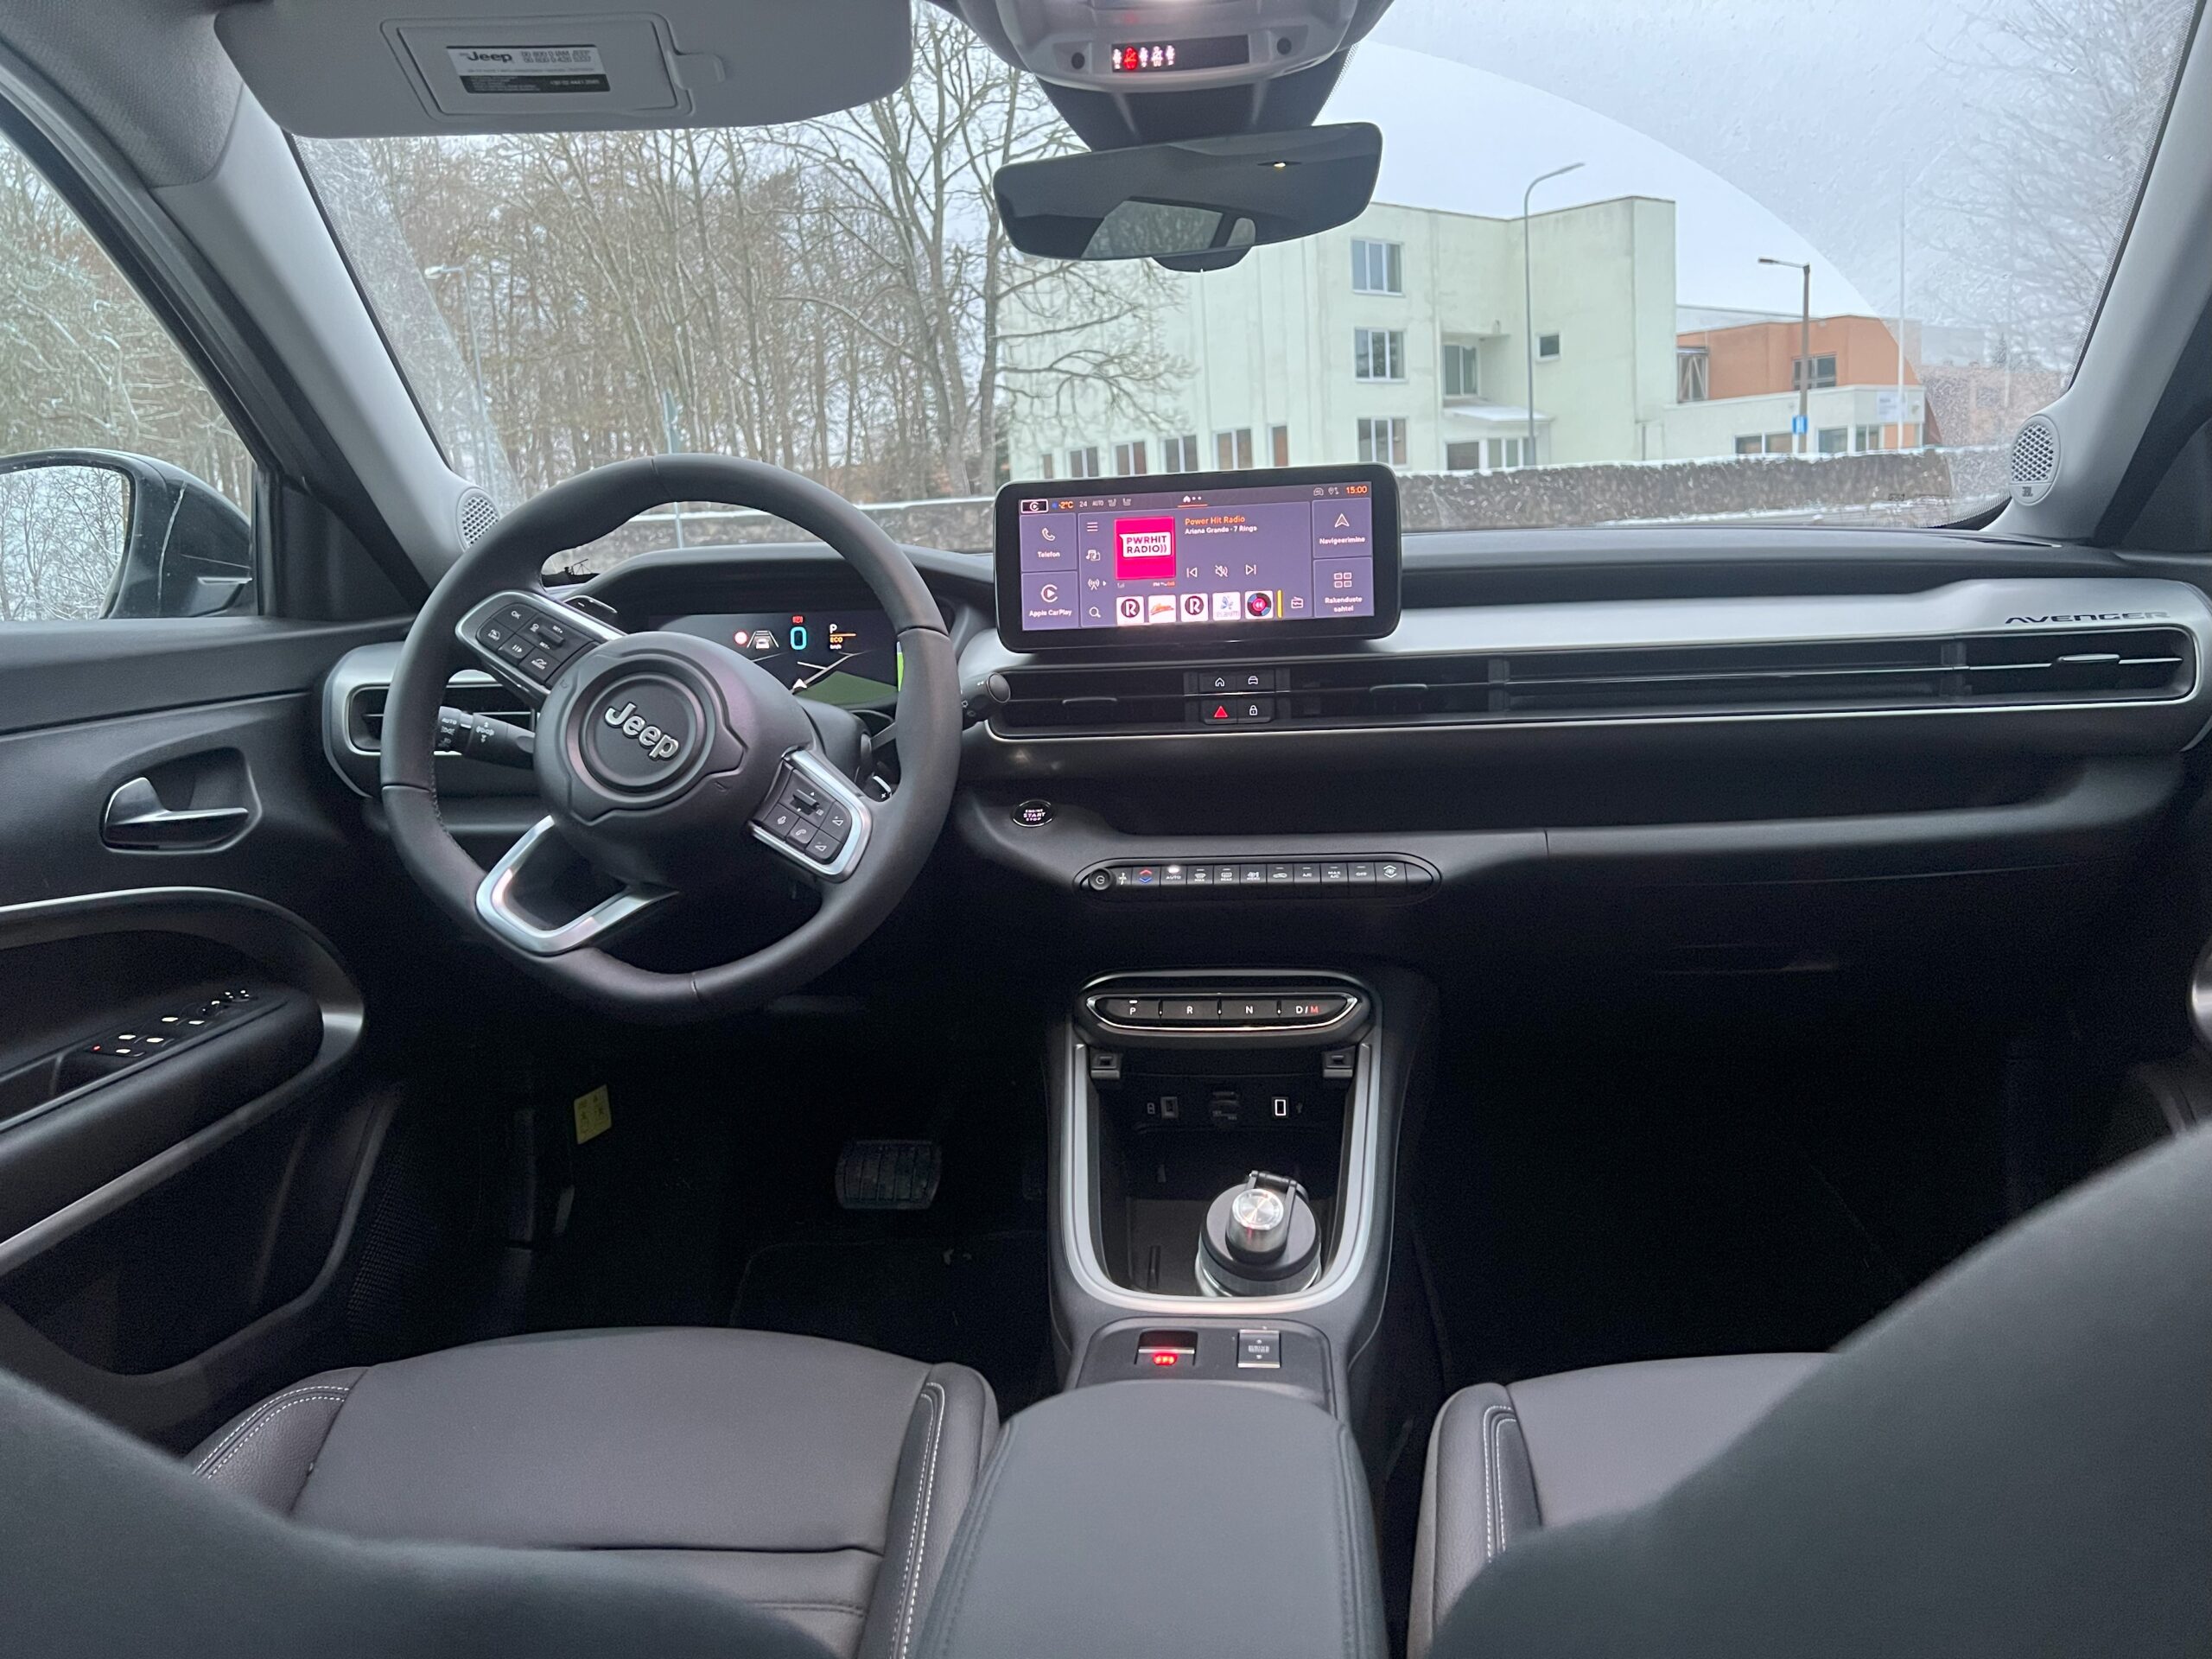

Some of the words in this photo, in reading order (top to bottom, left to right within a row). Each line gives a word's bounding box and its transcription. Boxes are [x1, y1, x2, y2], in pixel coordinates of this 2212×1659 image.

[466, 51, 513, 63] Jeep
[1224, 515, 1245, 524] Radio
[1126, 536, 1167, 544] PWRHIT
[2005, 612, 2171, 624] AVENGER
[830, 623, 838, 634] P
[790, 626, 807, 651] 0
[605, 702, 680, 760] Jeep
[1129, 1007, 1137, 1015] P
[1186, 1006, 1194, 1014] R
[1245, 1006, 1254, 1014] N
